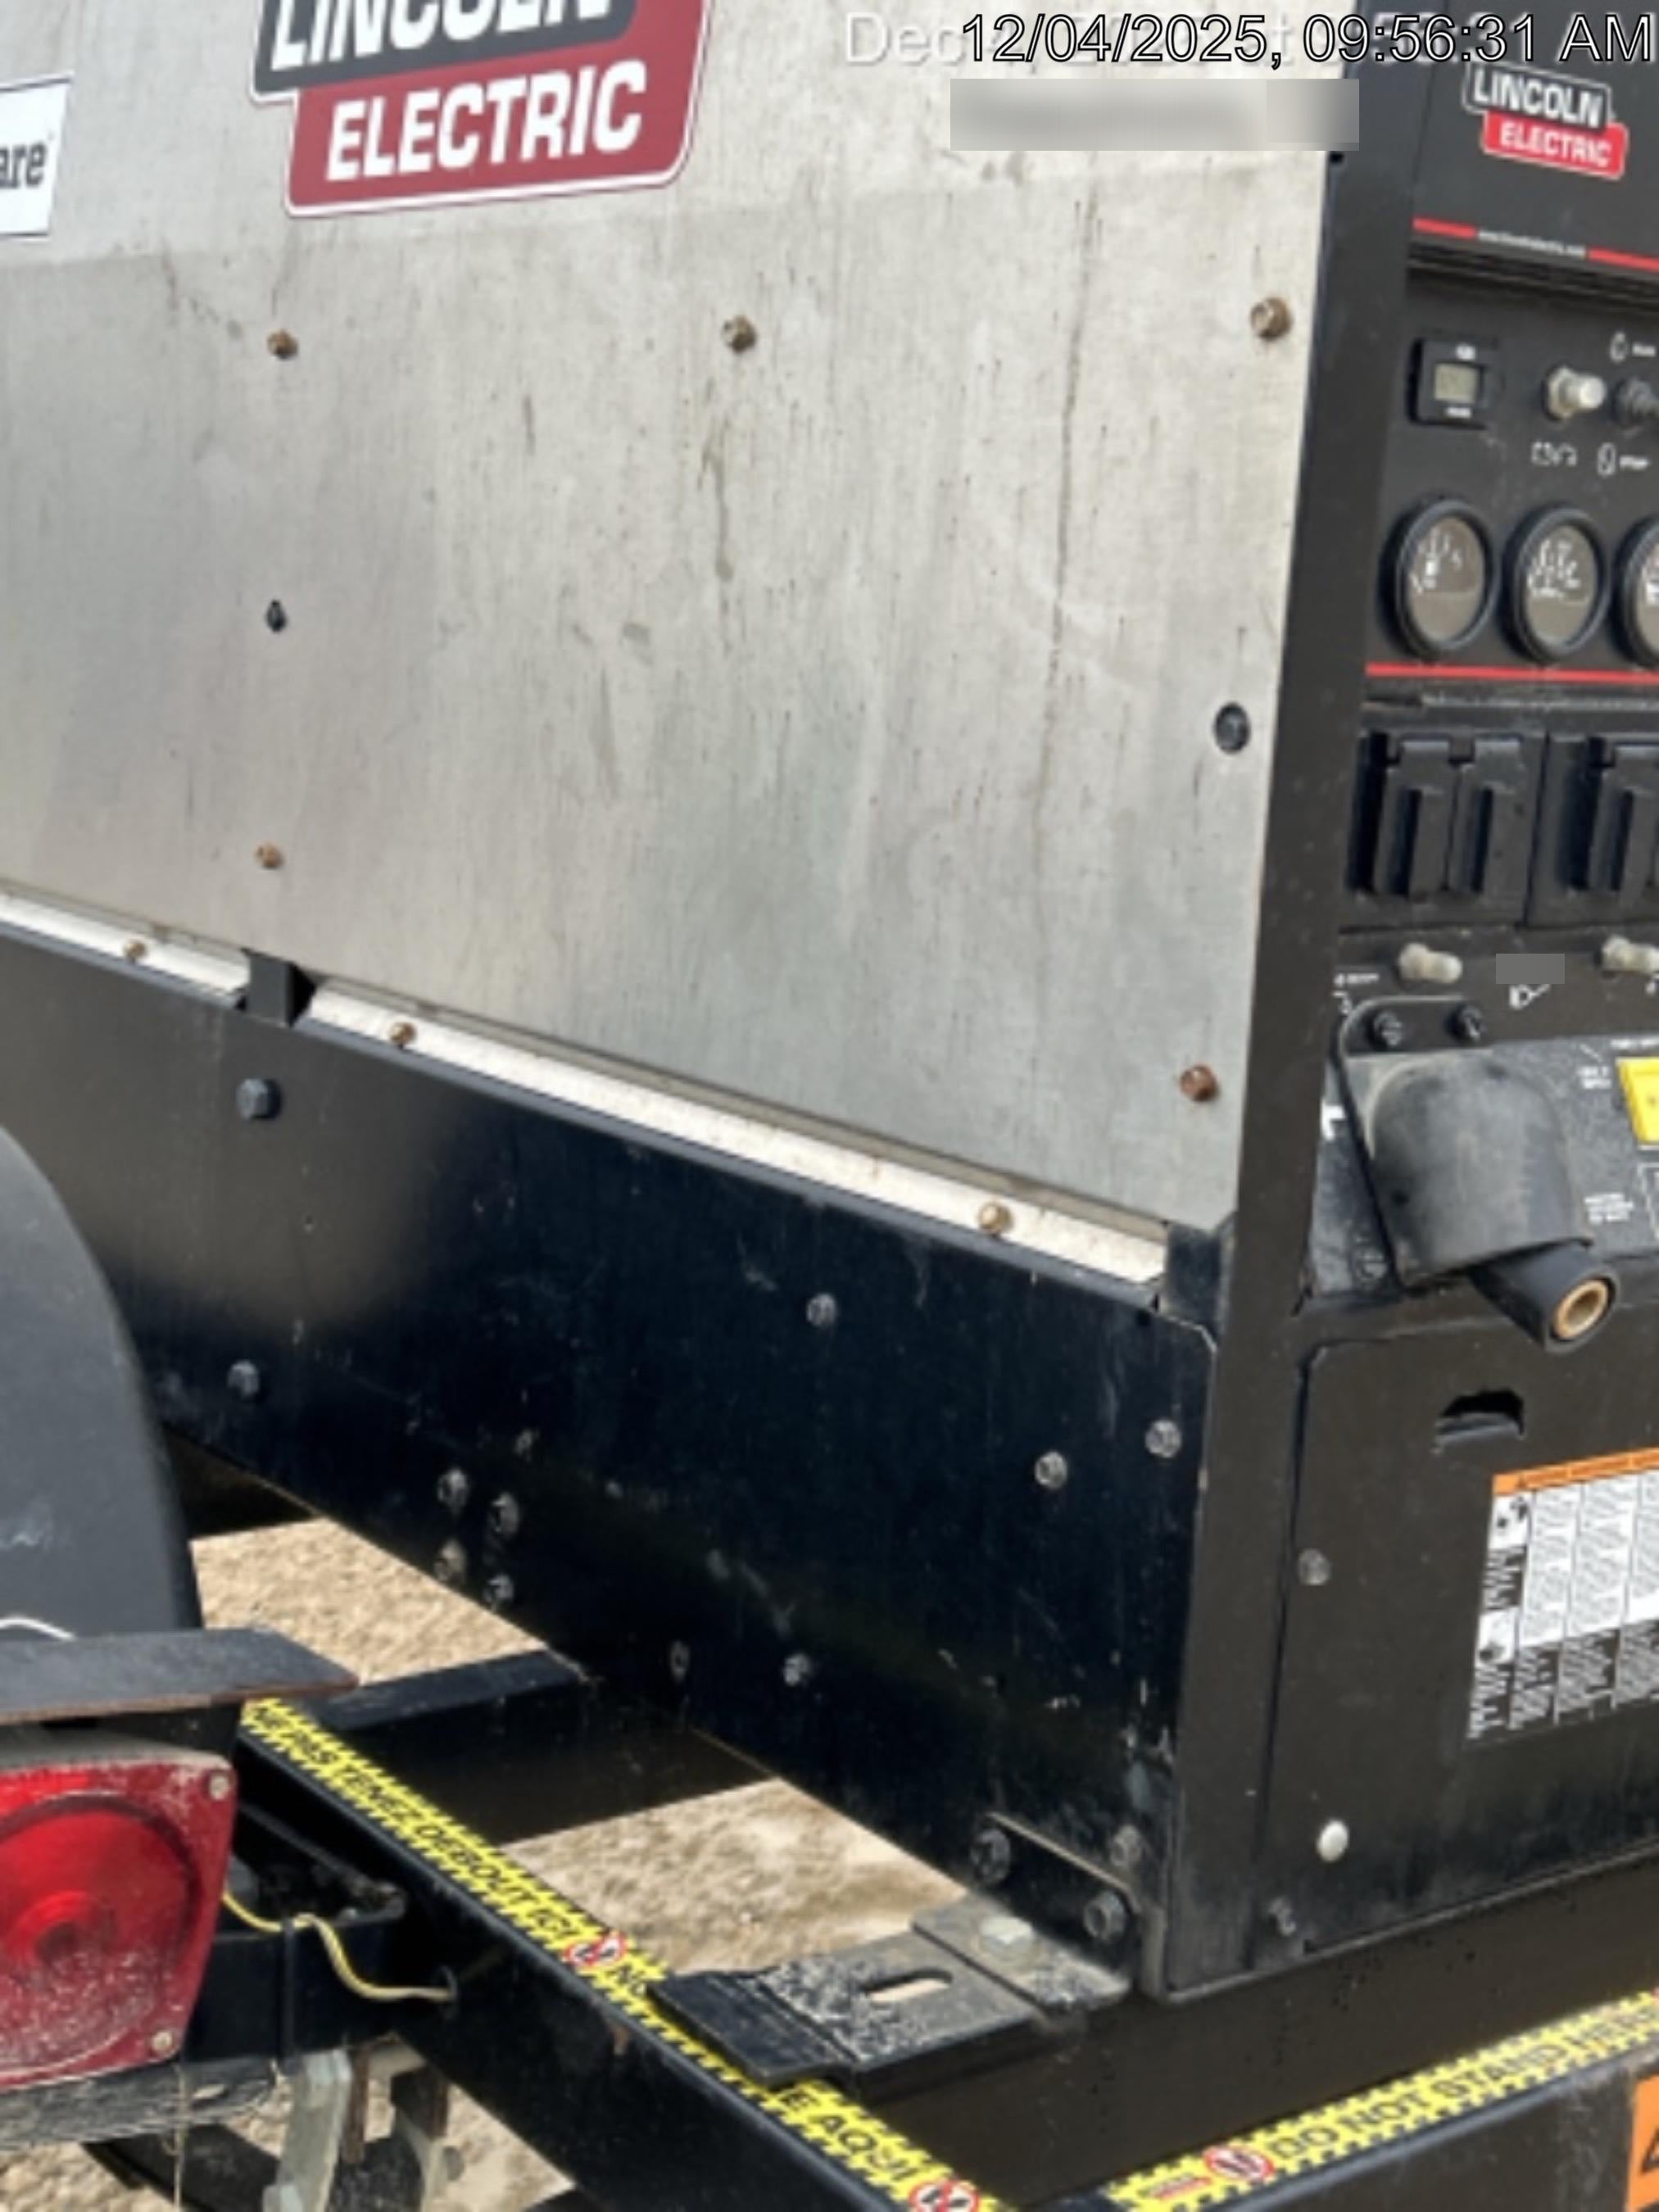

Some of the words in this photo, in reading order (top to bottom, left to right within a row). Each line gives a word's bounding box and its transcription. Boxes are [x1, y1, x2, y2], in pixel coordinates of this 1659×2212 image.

[270, 0, 611, 71] LINC
[325, 60, 647, 180] ELECTRIC
[1474, 67, 1603, 129] LINCOLN
[1498, 120, 1612, 169] ELECTRIC
[1267, 2128, 1339, 2159] DO
[1339, 2089, 1430, 2133] NOT
[1431, 2044, 1568, 2098] STAND
